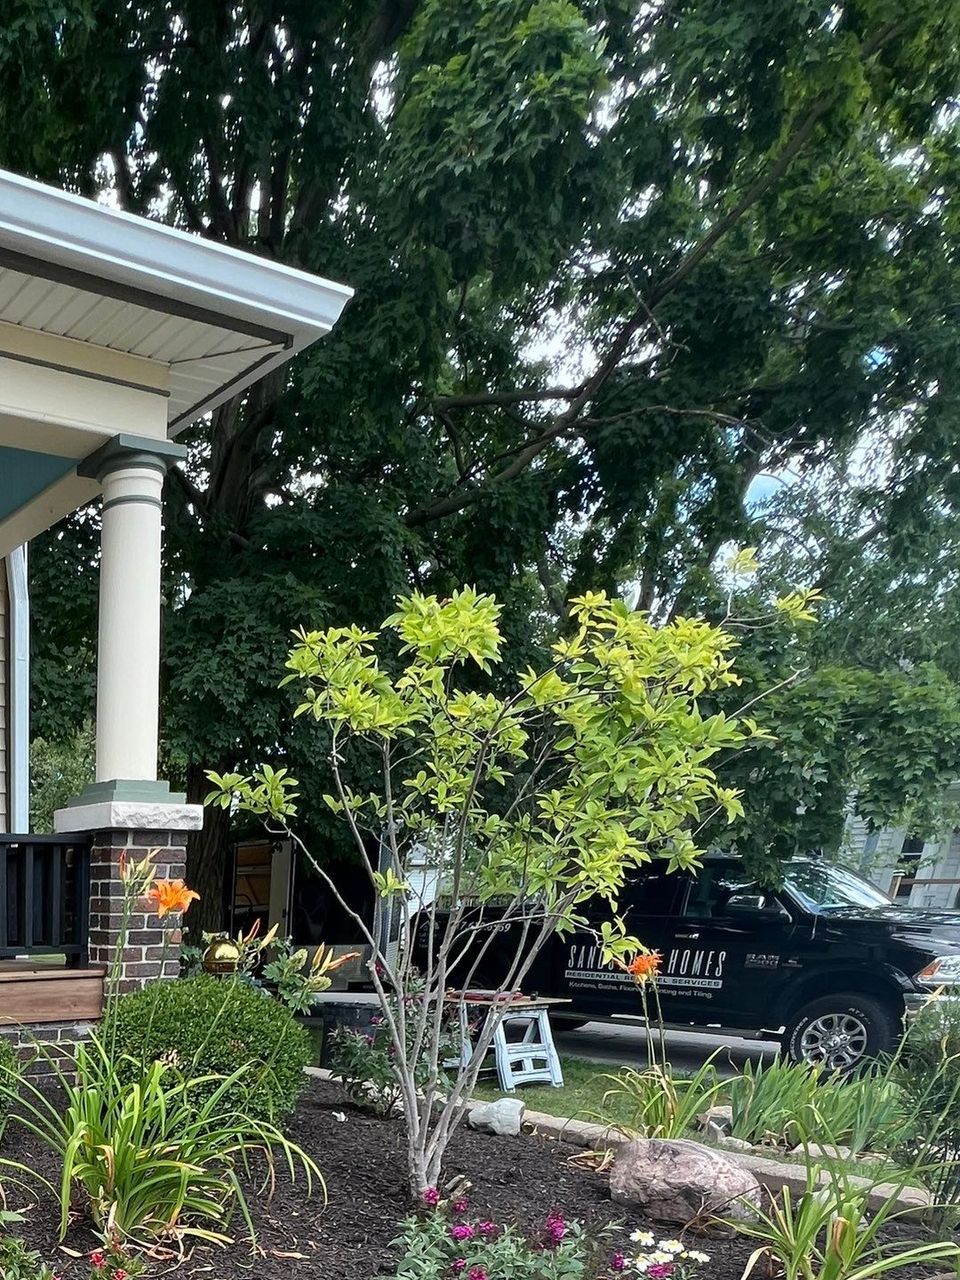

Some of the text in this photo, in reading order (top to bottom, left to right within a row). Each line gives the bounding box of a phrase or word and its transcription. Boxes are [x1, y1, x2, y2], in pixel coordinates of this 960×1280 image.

[667, 949, 726, 977] HOMES
[566, 971, 620, 980] RESIDENTIAL
[672, 979, 720, 987] SERVICES
